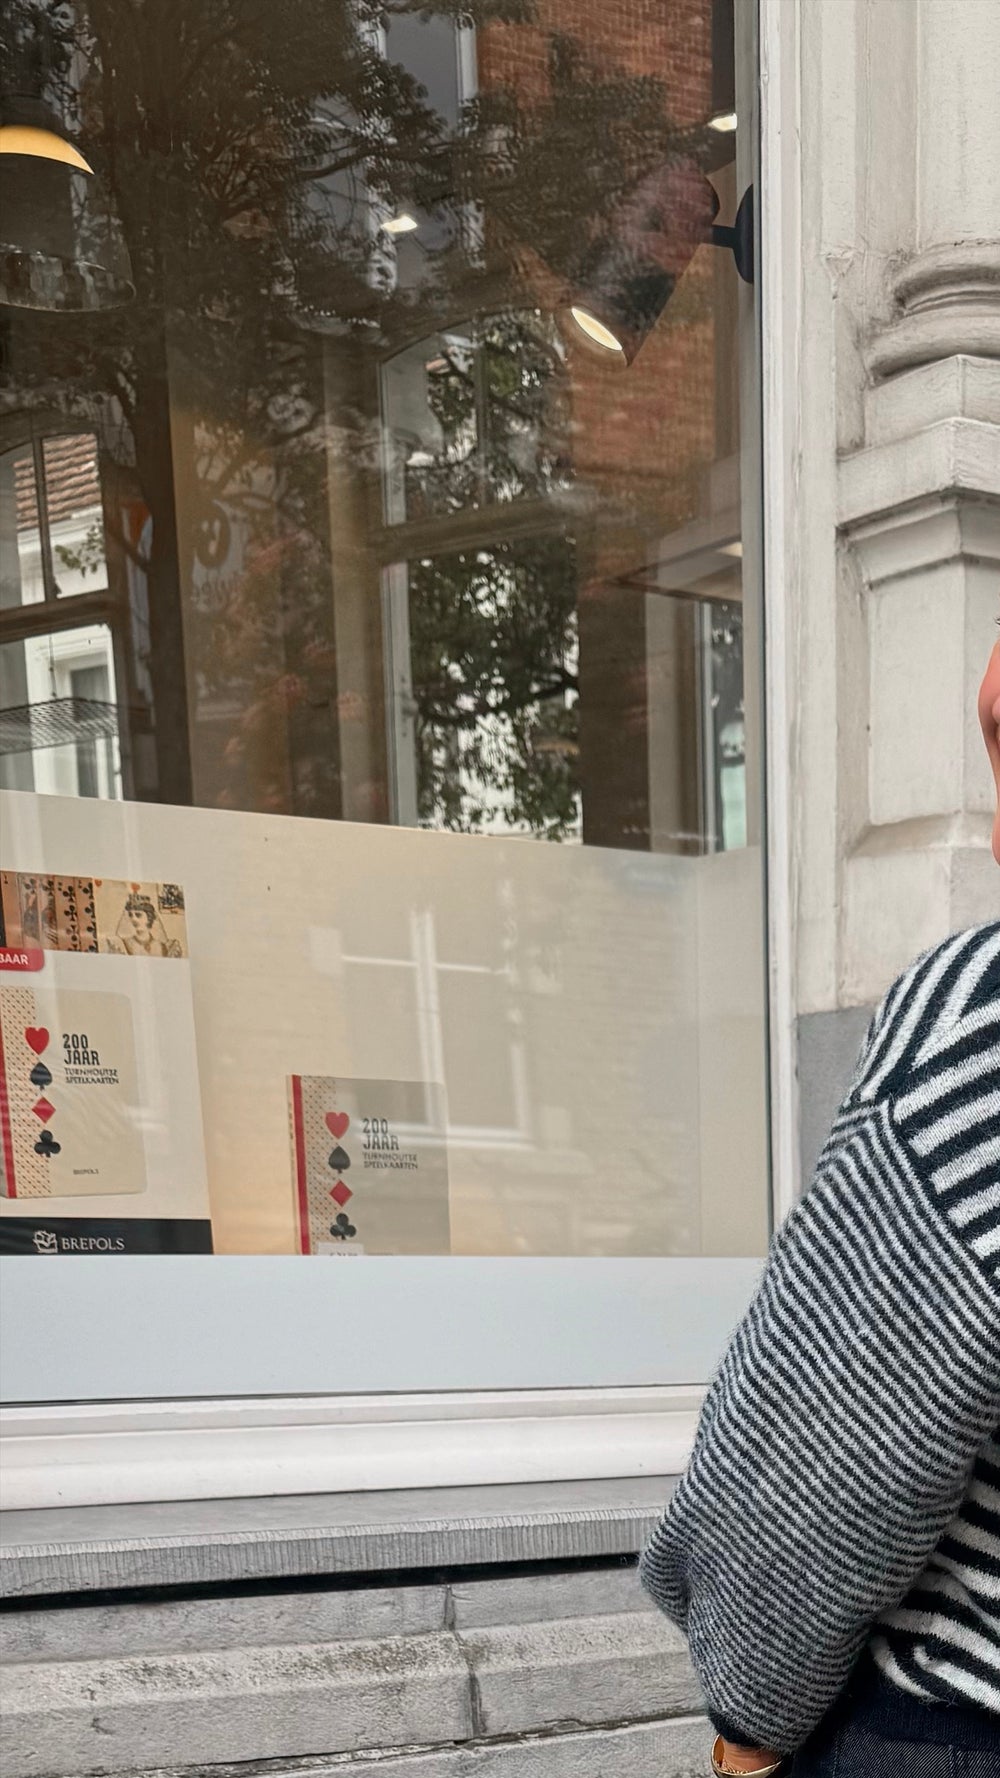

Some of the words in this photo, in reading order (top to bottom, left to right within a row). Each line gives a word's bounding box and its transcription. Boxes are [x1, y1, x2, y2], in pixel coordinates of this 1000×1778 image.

[62, 1033, 89, 1049] 200
[63, 1049, 100, 1066] JAAR
[362, 1117, 389, 1134] 200
[362, 1134, 400, 1150] JAAR
[61, 1237, 125, 1251] BREPOLS
